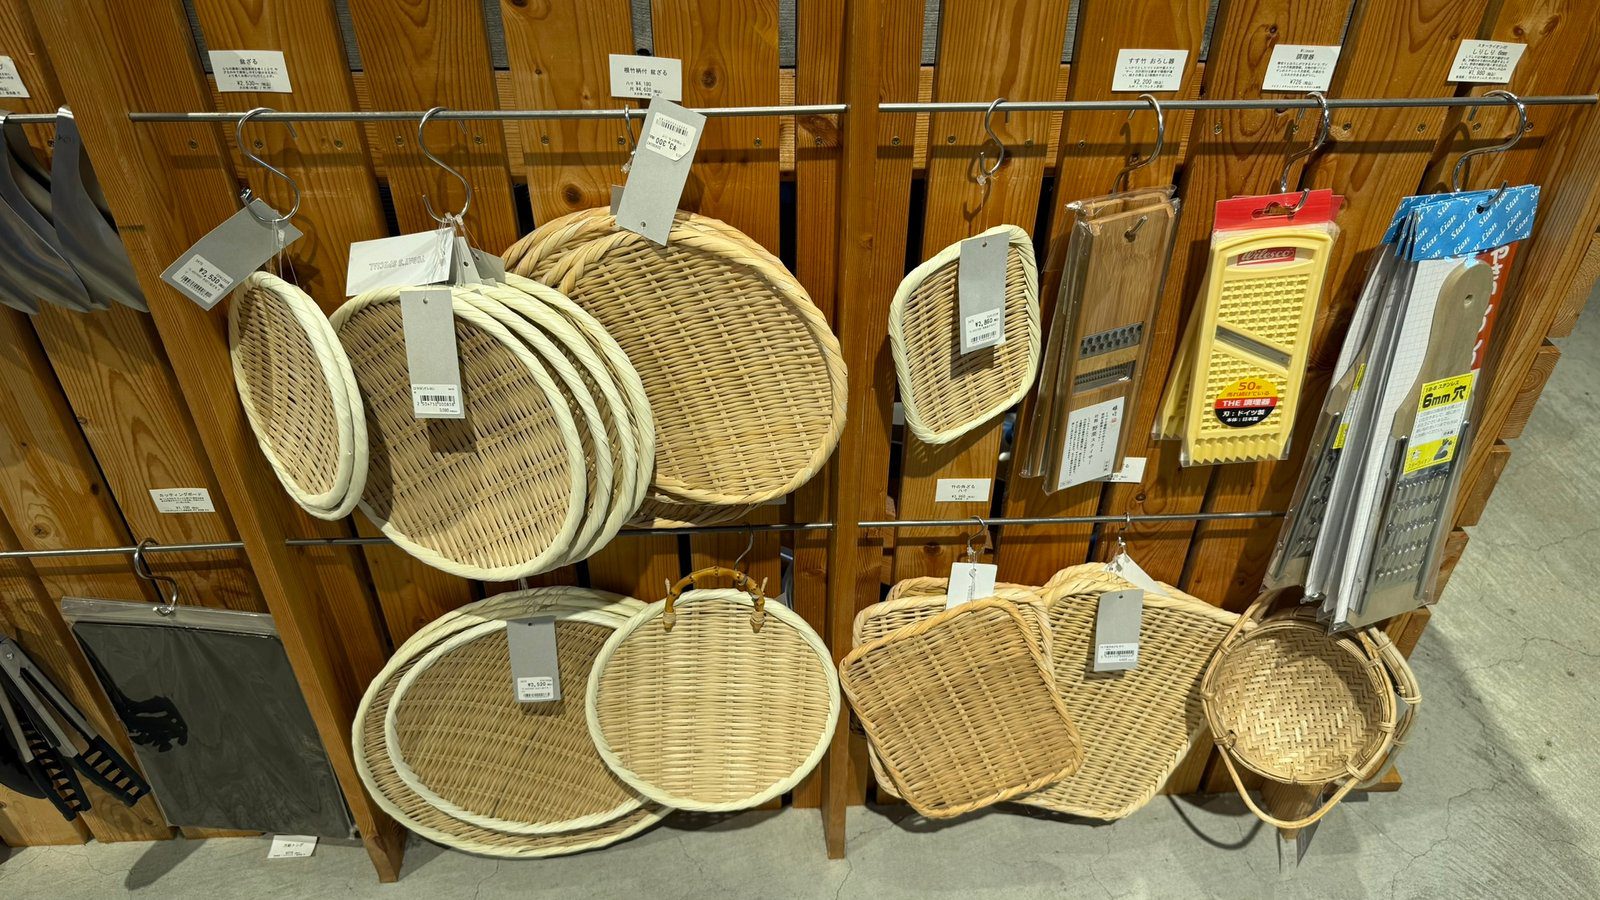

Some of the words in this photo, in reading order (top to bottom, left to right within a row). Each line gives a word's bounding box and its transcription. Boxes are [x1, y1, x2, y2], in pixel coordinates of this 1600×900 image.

[655, 137, 677, 151] ¥3,300
[1505, 193, 1520, 213] Star
[1478, 207, 1494, 227] Star
[1506, 210, 1522, 231] Lion
[1514, 214, 1530, 234] Star
[1421, 234, 1438, 254] Star
[1439, 214, 1457, 236] Lion
[1450, 220, 1467, 240] Star
[1481, 222, 1497, 243] Lion
[1453, 236, 1470, 255] Lion
[199, 267, 220, 284] ¥2,530
[1243, 398, 1271, 406] 調理器
[1422, 392, 1451, 408] 6mm
[1451, 385, 1467, 402] 穴
